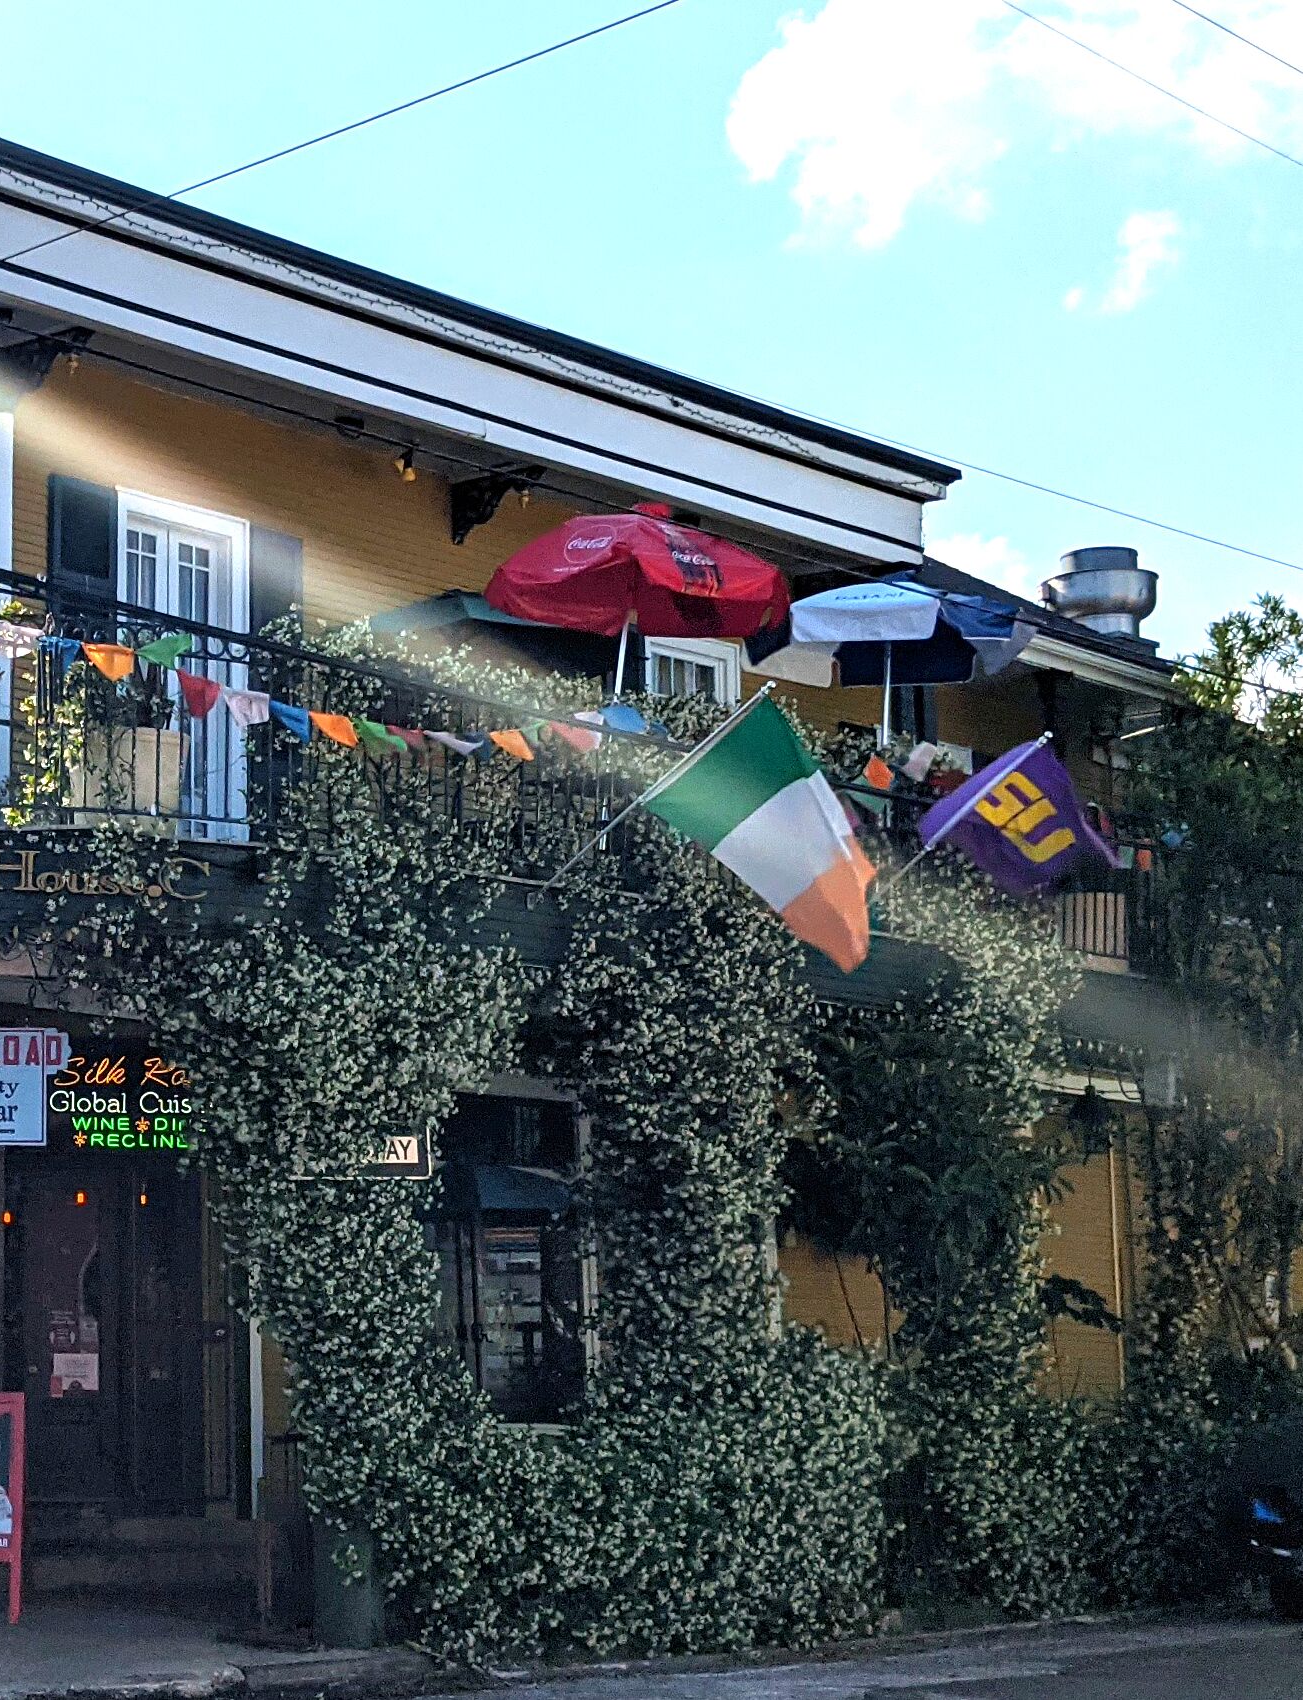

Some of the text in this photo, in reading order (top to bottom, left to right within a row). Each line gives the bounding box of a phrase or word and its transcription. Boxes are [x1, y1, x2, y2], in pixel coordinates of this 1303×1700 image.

[54, 1055, 192, 1087] Silk Ro
[49, 1090, 127, 1114] Global
[72, 1117, 130, 1131] WINE
